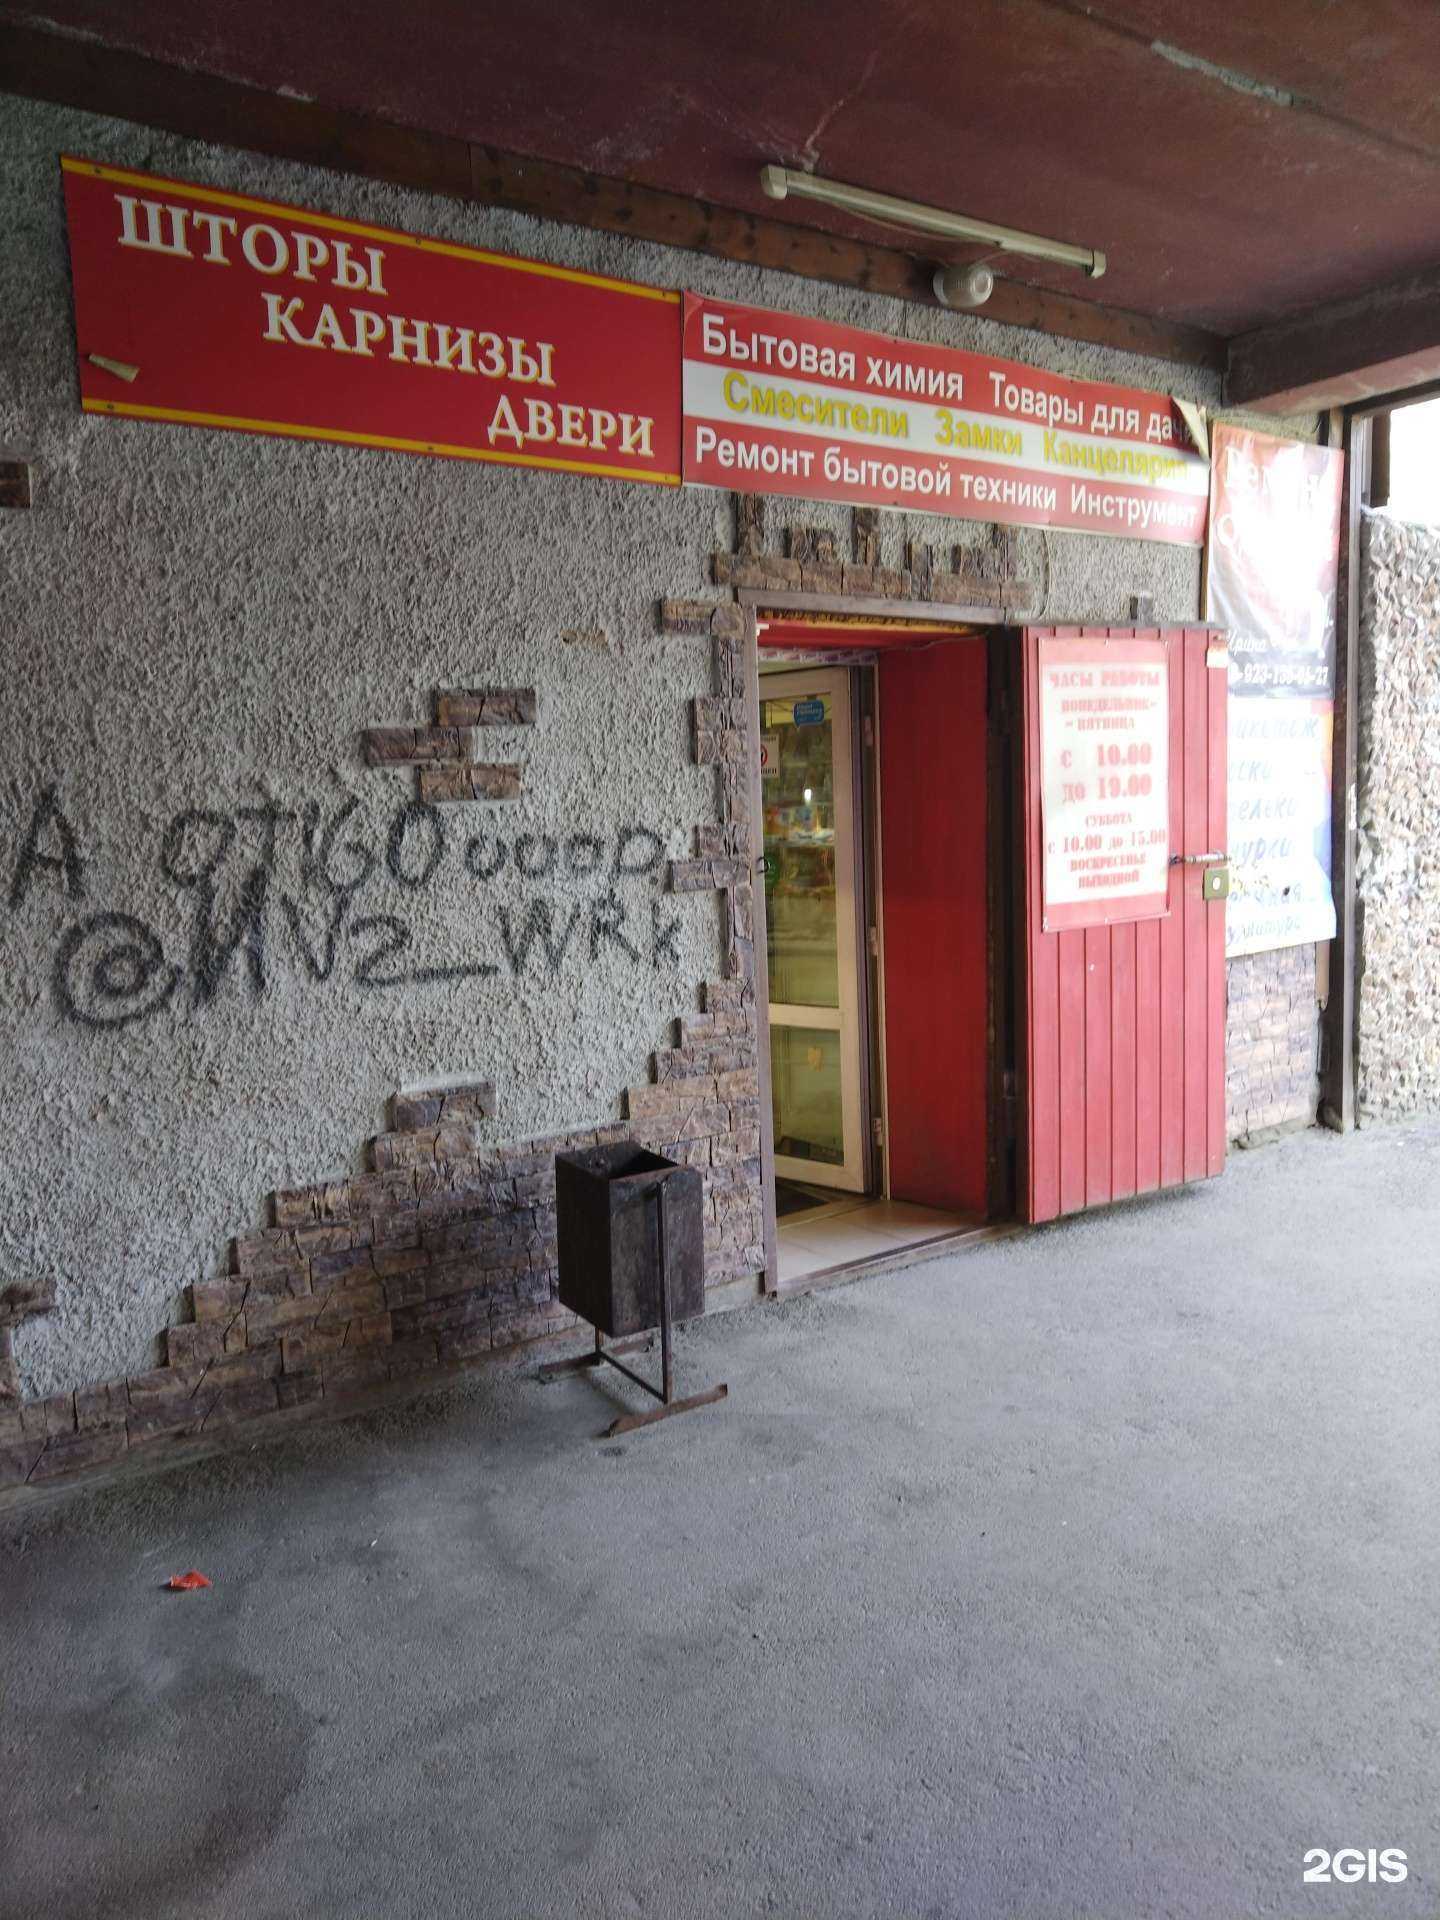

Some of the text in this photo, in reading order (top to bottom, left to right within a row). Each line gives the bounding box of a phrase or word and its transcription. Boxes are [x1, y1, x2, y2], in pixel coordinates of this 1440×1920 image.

[114, 194, 388, 296] ШТОРЫ
[261, 292, 556, 387] КАРНИЗЫ
[702, 313, 855, 381] Бытовая
[866, 356, 964, 401] химия
[989, 371, 1083, 427] Товары
[1091, 403, 1140, 435] для
[487, 395, 655, 458] ДВЕРИ
[723, 370, 908, 438] Смесители
[934, 408, 1023, 457] Замки
[696, 425, 1197, 529] Ремонт бытовой техники Инструмент
[1049, 670, 1160, 690] ЧАСЫ РАБОТЫ
[1096, 742, 1153, 767] 10.00
[1096, 773, 1153, 800] 19.00
[1062, 833, 1103, 854] 10.00
[1129, 828, 1167, 849] 15.00
